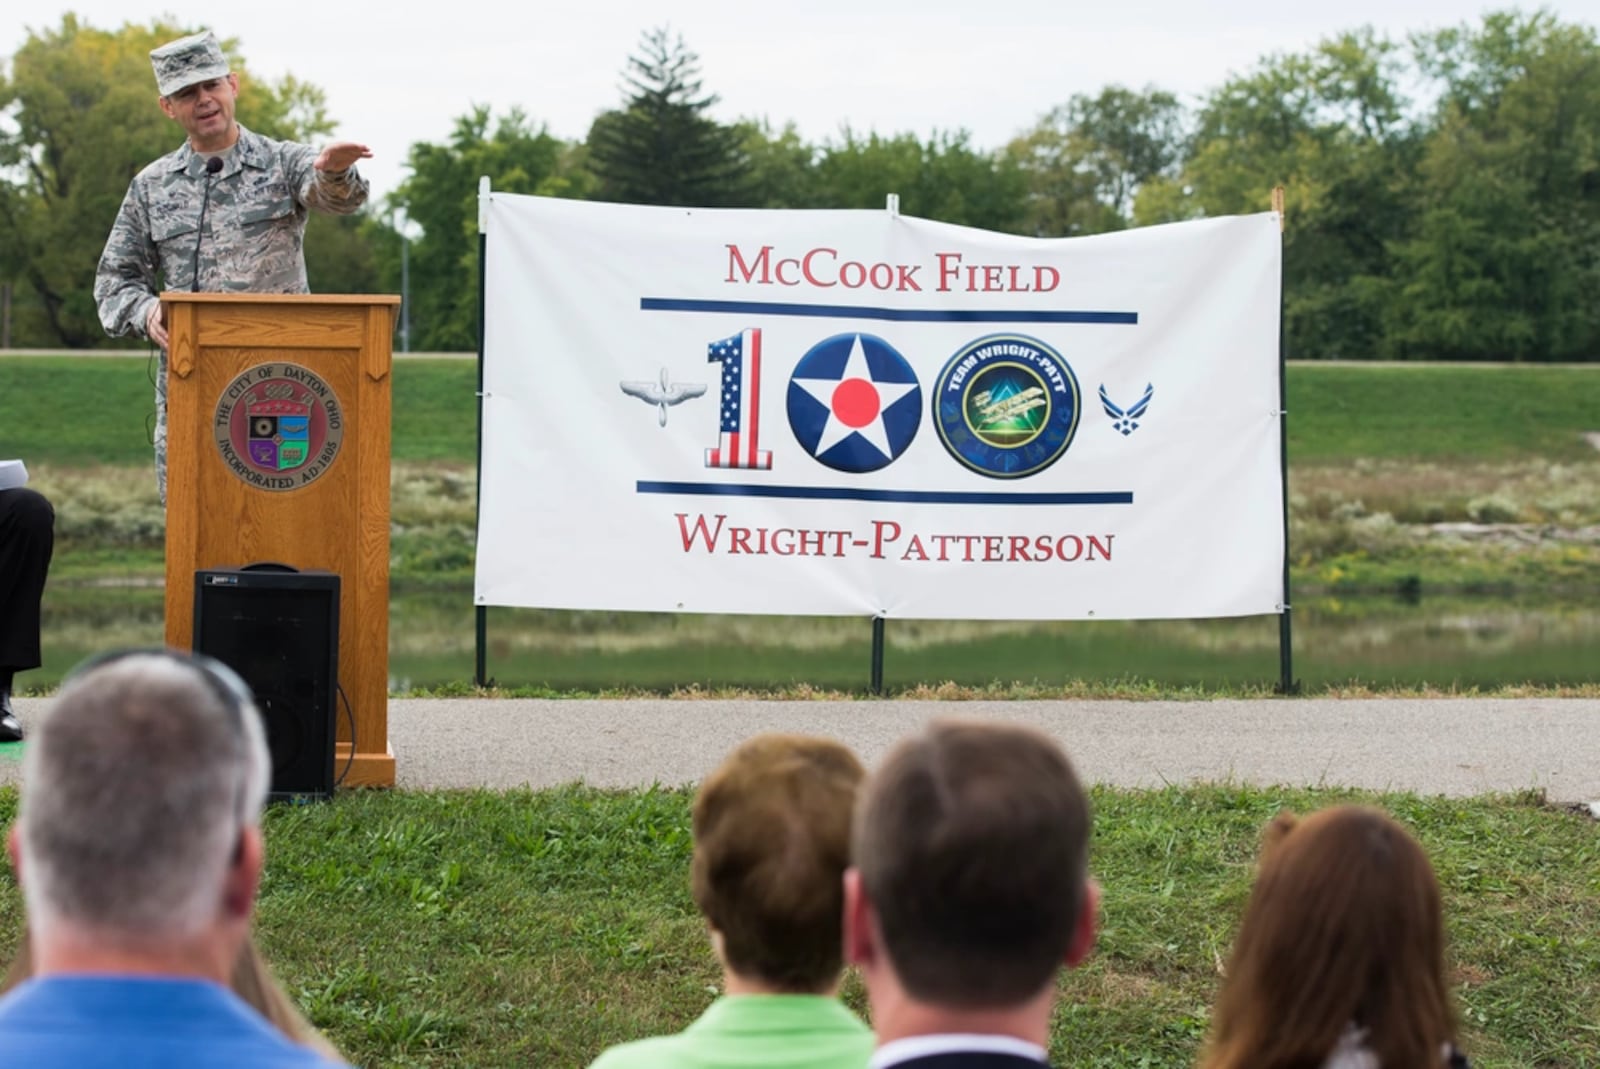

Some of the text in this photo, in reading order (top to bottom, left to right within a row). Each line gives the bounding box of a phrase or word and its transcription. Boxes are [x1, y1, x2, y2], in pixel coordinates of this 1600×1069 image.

[935, 253, 1061, 292] FIELD
[948, 344, 1066, 394] TEAM WRIGHT-PATT
[217, 367, 341, 431] THE CITY OF DAYTON OHIO
[219, 438, 295, 489] INCORPORATED
[317, 441, 337, 468] 1805
[674, 513, 1116, 562] WRIGHT-PATTERSON
